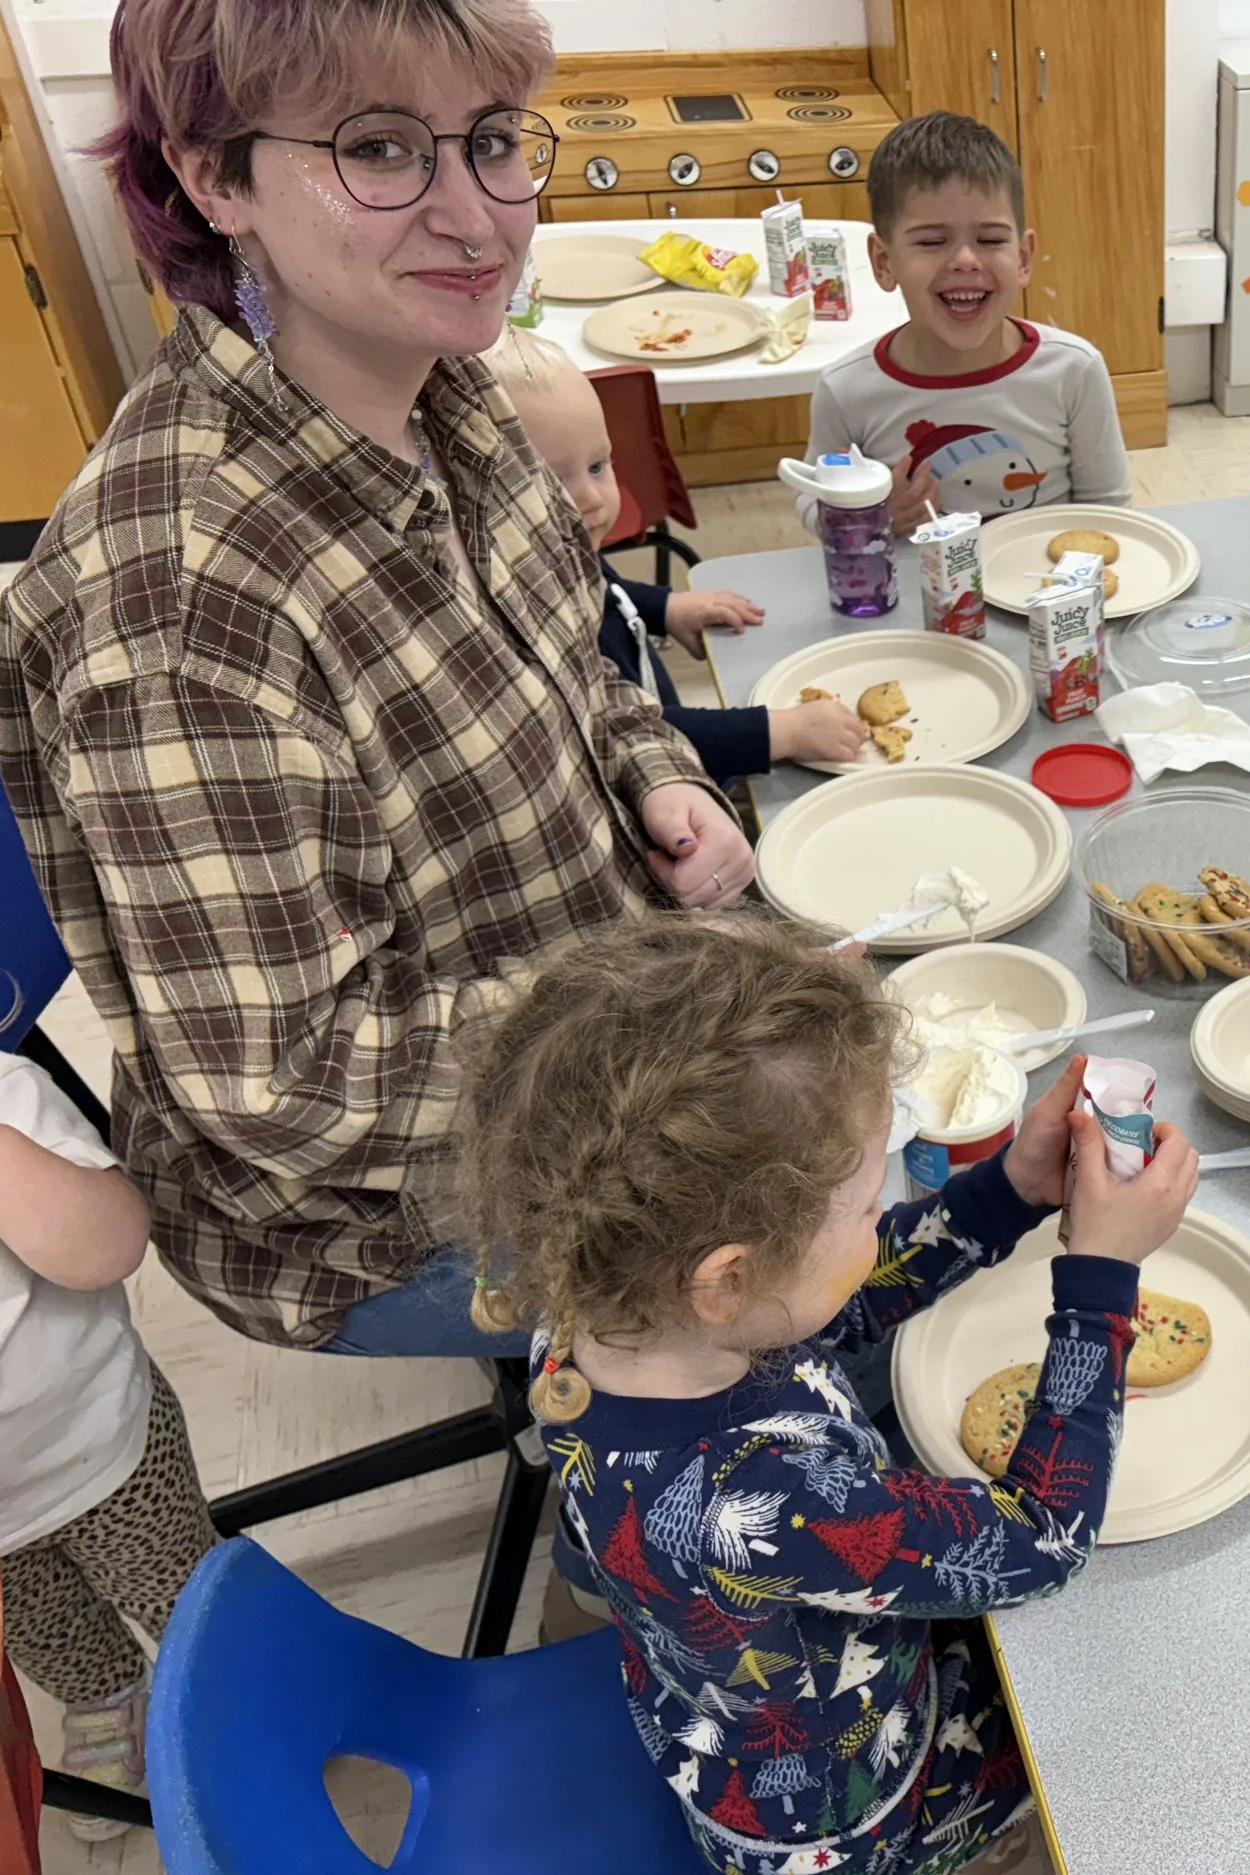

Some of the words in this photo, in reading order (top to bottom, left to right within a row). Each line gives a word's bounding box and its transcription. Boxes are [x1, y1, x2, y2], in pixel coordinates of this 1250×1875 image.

[945, 538, 978, 560] Juicy
[947, 550, 975, 569] Juice
[1051, 606, 1090, 626] Juicy
[1053, 619, 1087, 636] Juice
[1103, 1117, 1140, 1139] DECORATES
